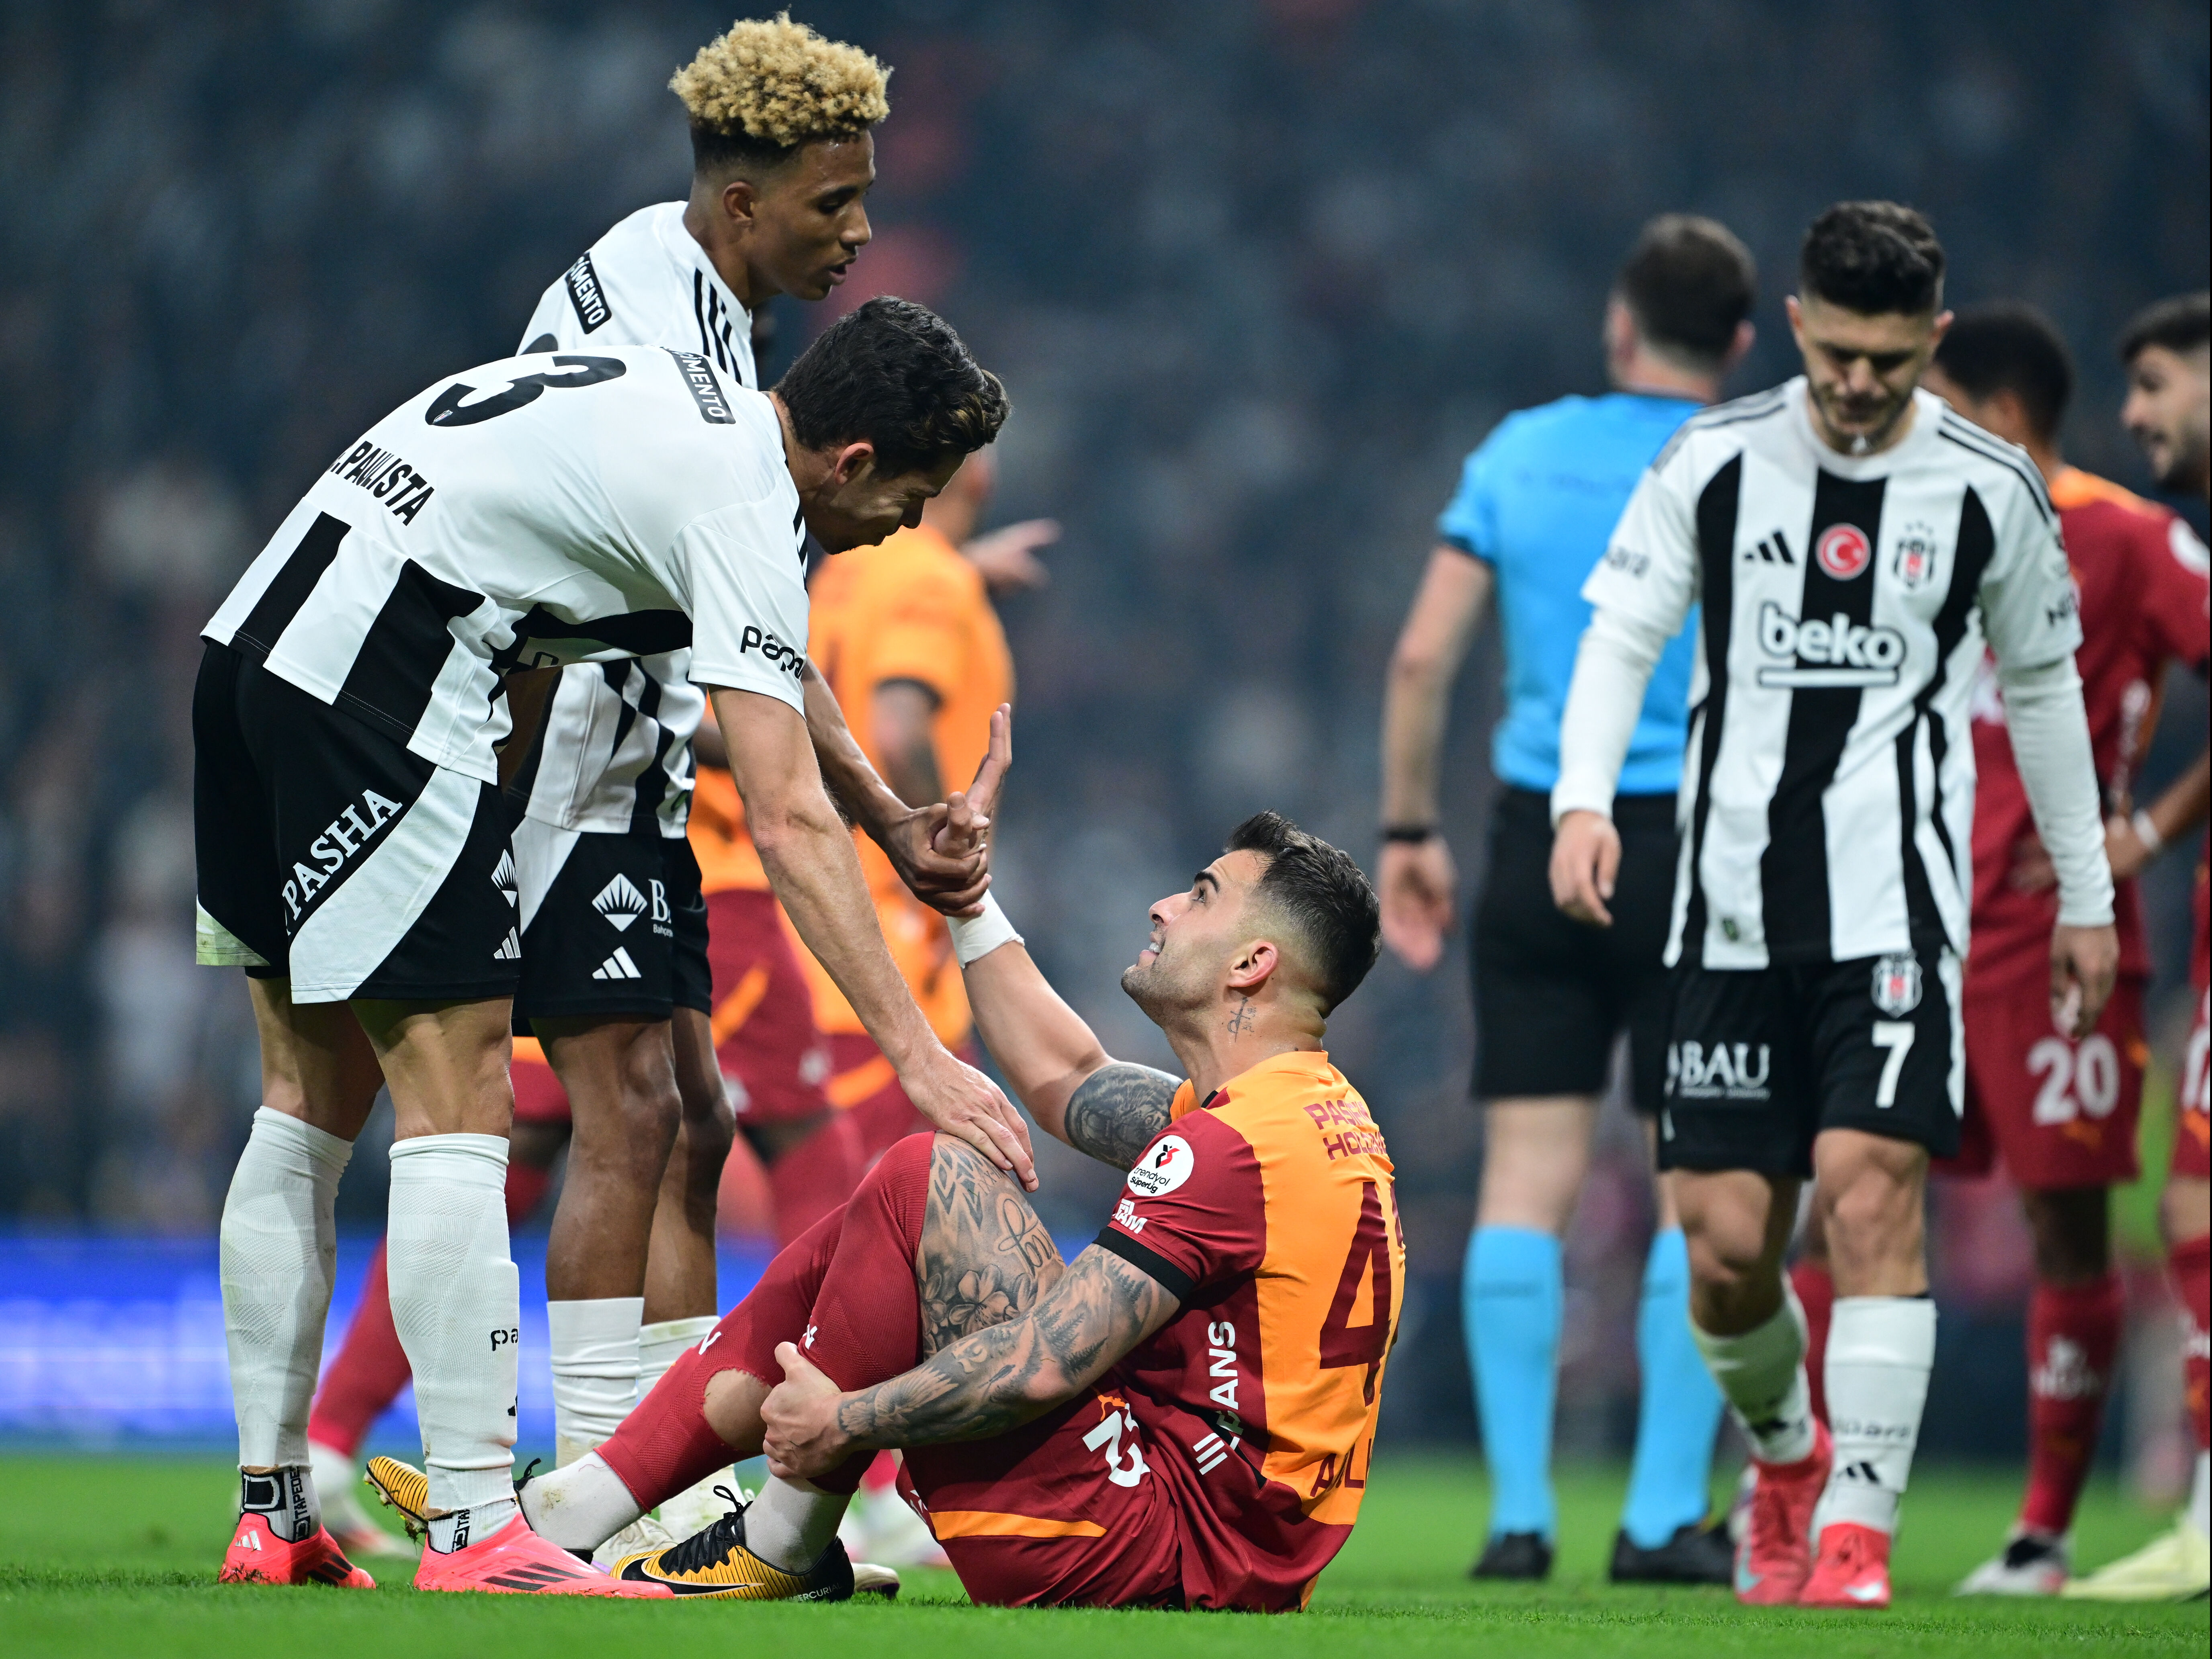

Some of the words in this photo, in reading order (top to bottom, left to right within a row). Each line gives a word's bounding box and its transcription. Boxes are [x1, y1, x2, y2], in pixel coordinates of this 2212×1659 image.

[425, 355, 627, 427] 3
[1759, 601, 1907, 668] beko
[1872, 1020, 1915, 1109] 7
[2026, 1033, 2122, 1125] 20
[1133, 1166, 1170, 1186] trendyol
